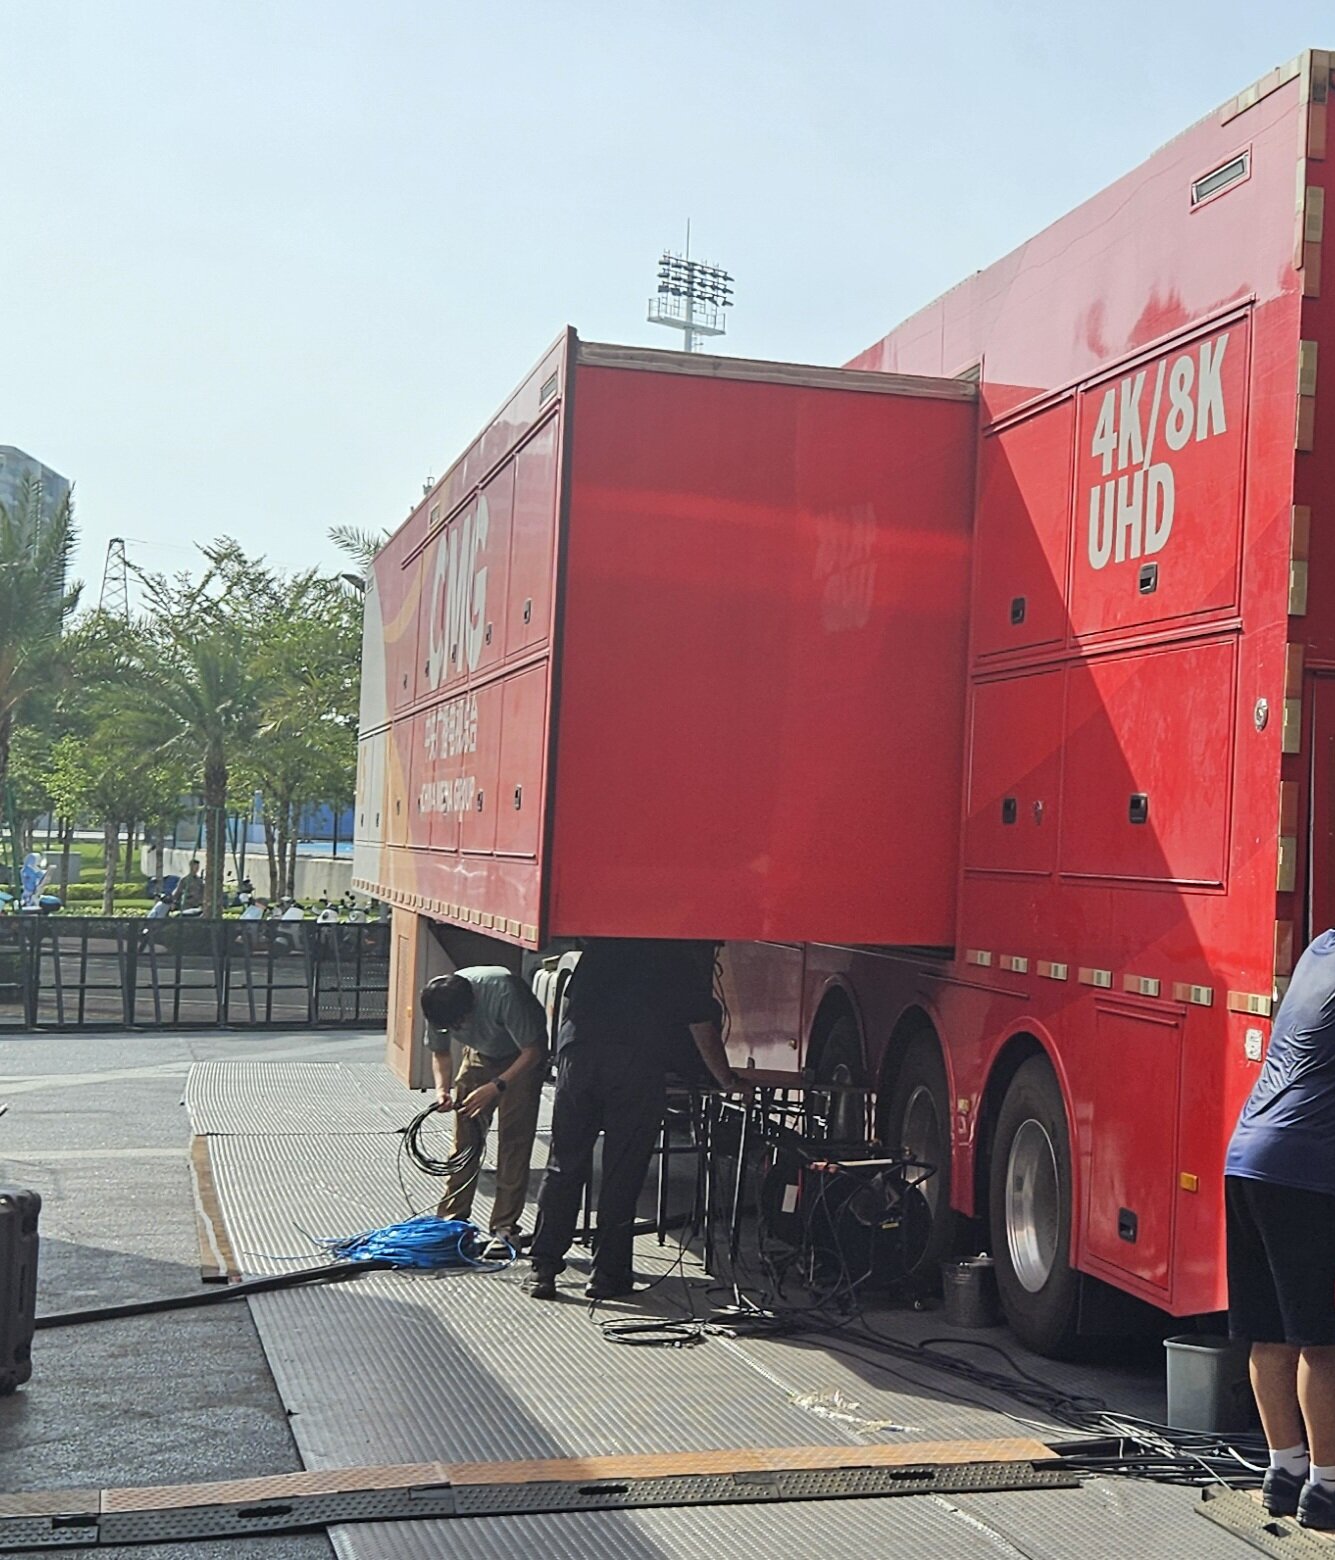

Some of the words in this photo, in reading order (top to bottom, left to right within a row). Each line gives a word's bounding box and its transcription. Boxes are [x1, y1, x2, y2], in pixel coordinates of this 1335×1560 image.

[1092, 333, 1230, 477] 4K/8K
[1088, 462, 1176, 571] UHD
[429, 494, 490, 690] CMG
